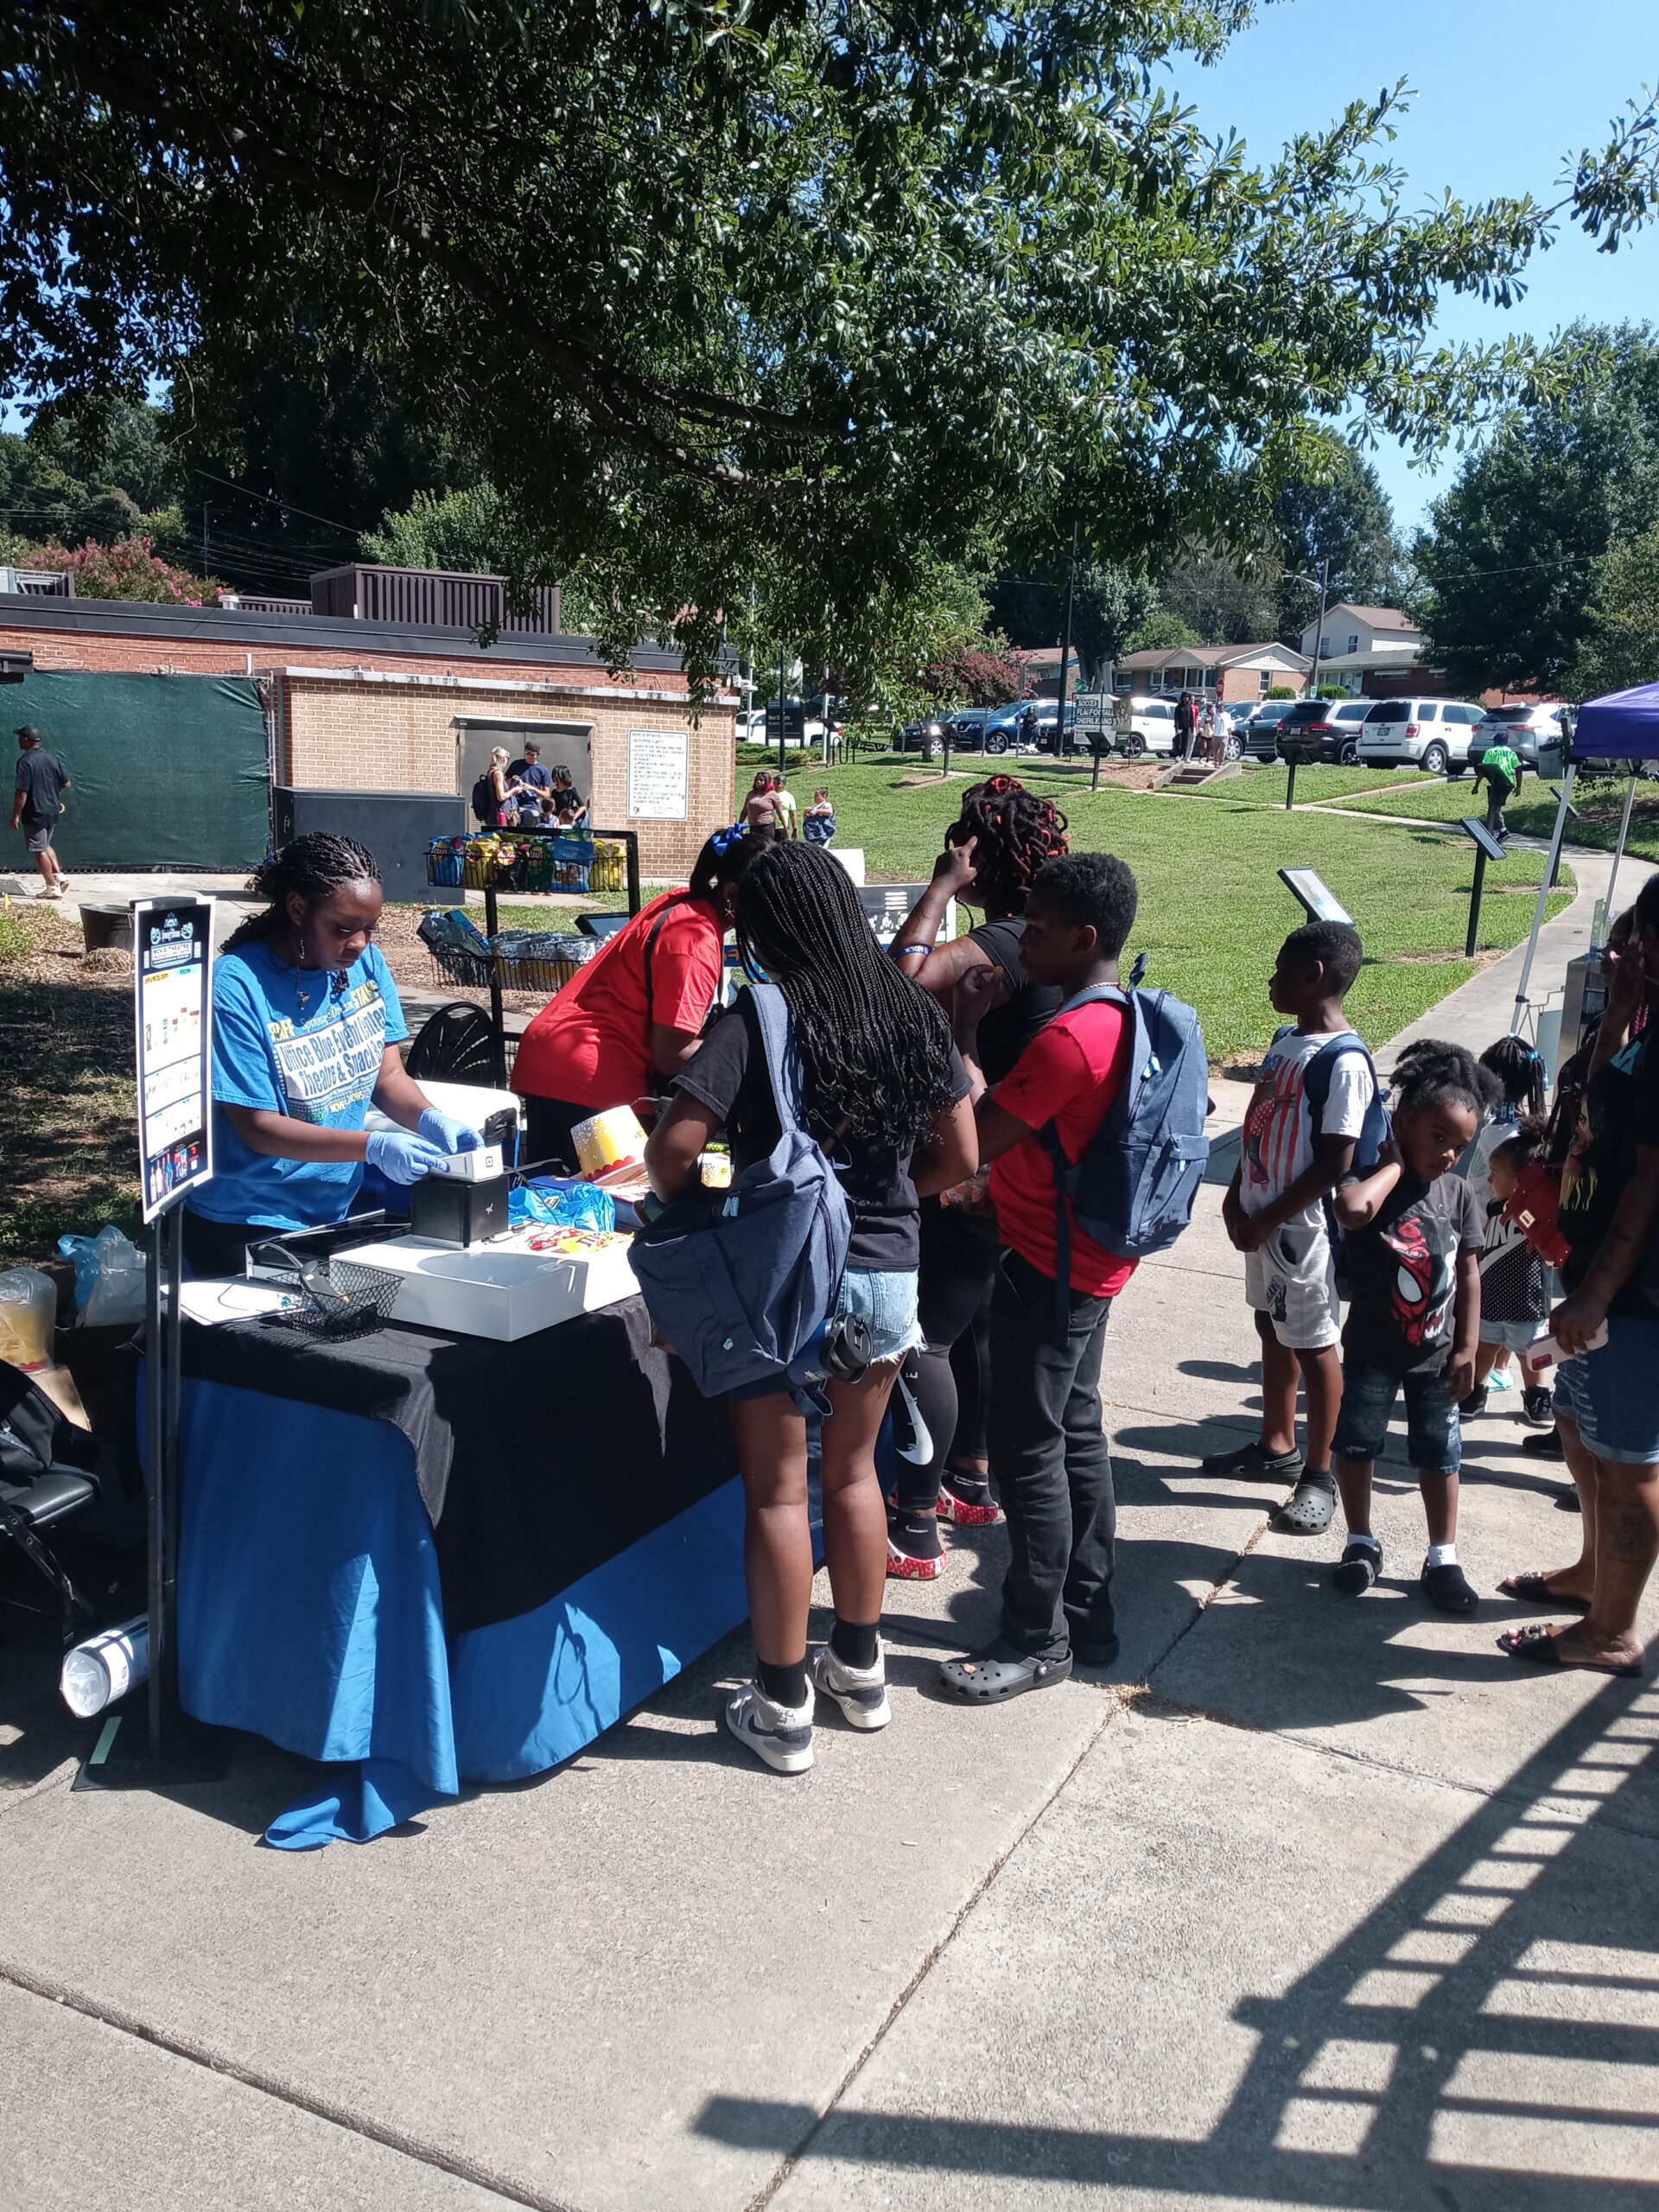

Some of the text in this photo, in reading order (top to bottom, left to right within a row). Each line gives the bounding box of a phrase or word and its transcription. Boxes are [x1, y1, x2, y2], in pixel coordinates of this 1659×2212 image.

[308, 1035, 337, 1064] Blue
[331, 1020, 361, 1054] Event
[336, 1061, 347, 1082] &
[342, 1042, 378, 1078] Snack
